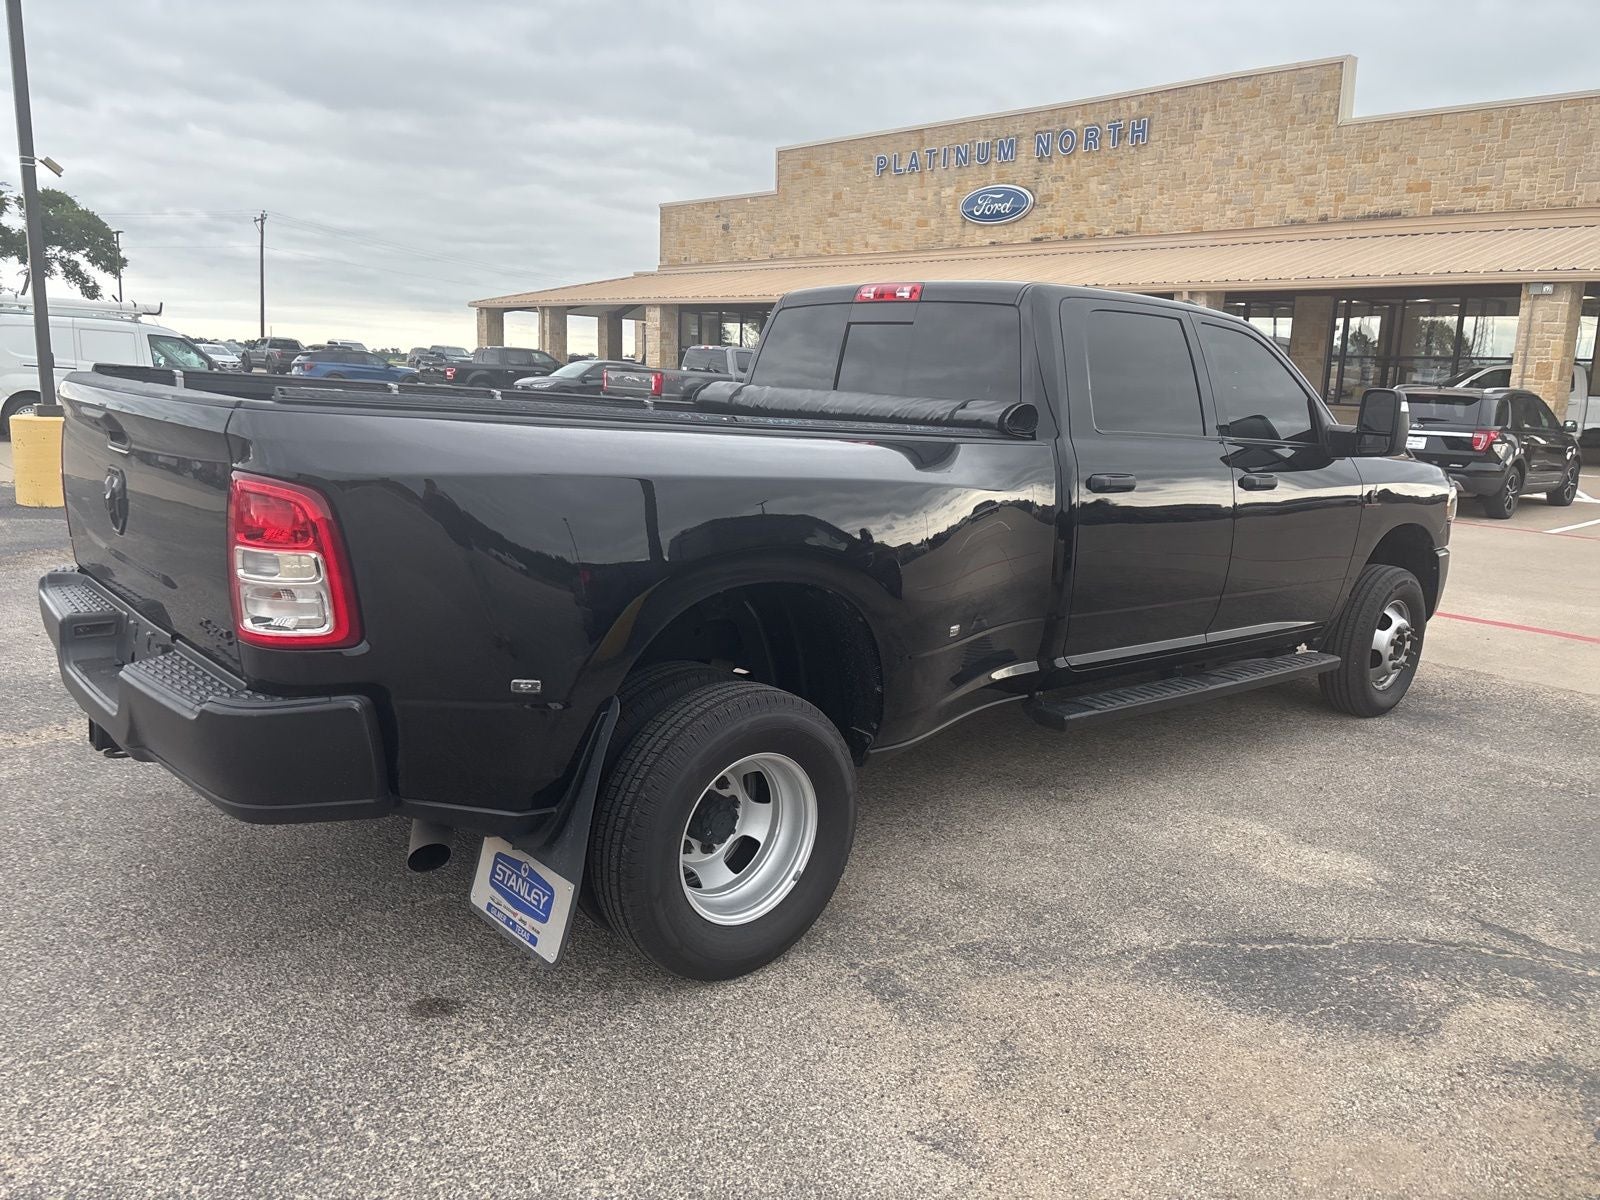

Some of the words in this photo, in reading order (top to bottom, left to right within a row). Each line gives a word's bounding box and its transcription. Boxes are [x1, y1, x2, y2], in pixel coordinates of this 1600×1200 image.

[875, 138, 1016, 176] PLATINUM
[1035, 118, 1148, 157] NORTH
[974, 194, 1014, 216] Ford
[494, 863, 549, 910] STANLEY
[515, 925, 531, 941] TEXAS
